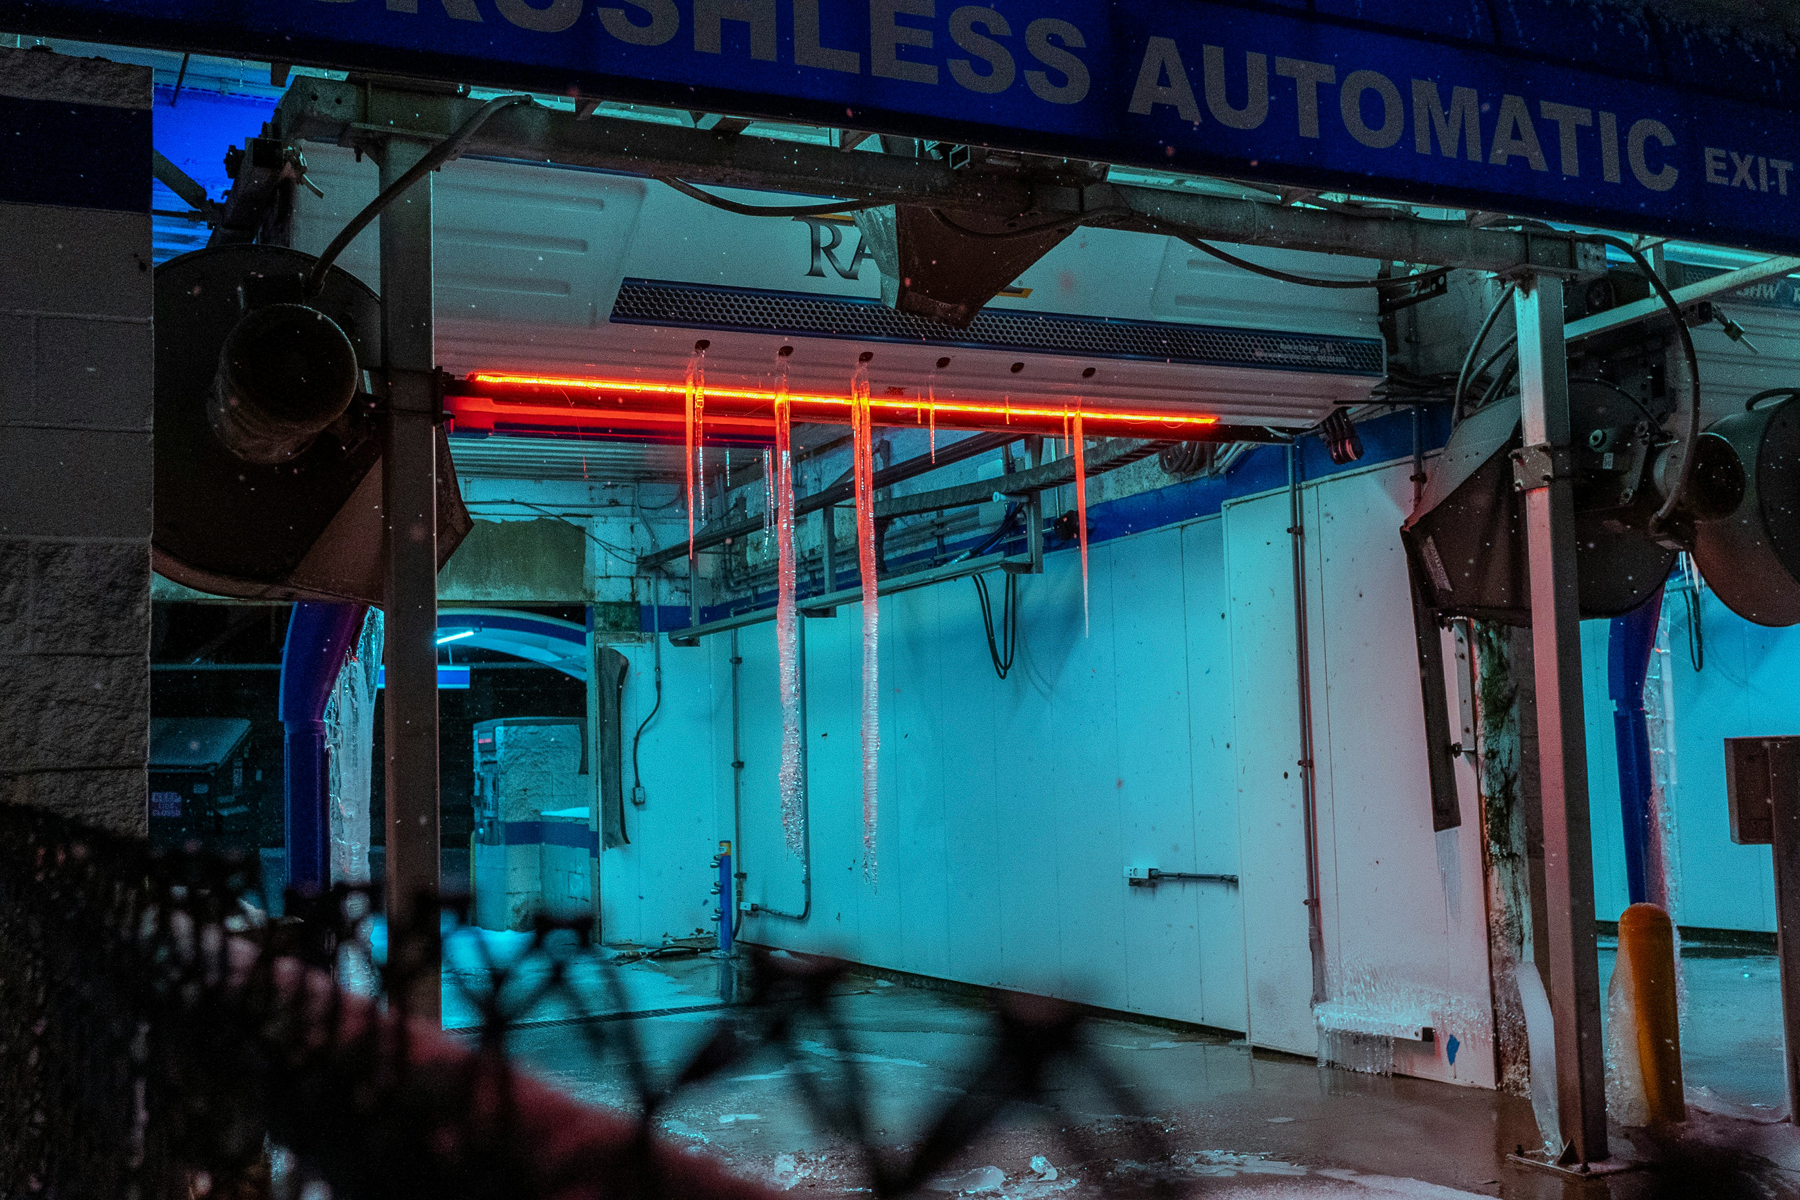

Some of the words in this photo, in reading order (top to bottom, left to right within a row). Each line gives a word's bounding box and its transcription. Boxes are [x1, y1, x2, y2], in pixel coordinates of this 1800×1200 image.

[318, 0, 1091, 105] SHLESS
[1128, 36, 1679, 192] AUTOMATIC
[1705, 147, 1793, 196] EXIT
